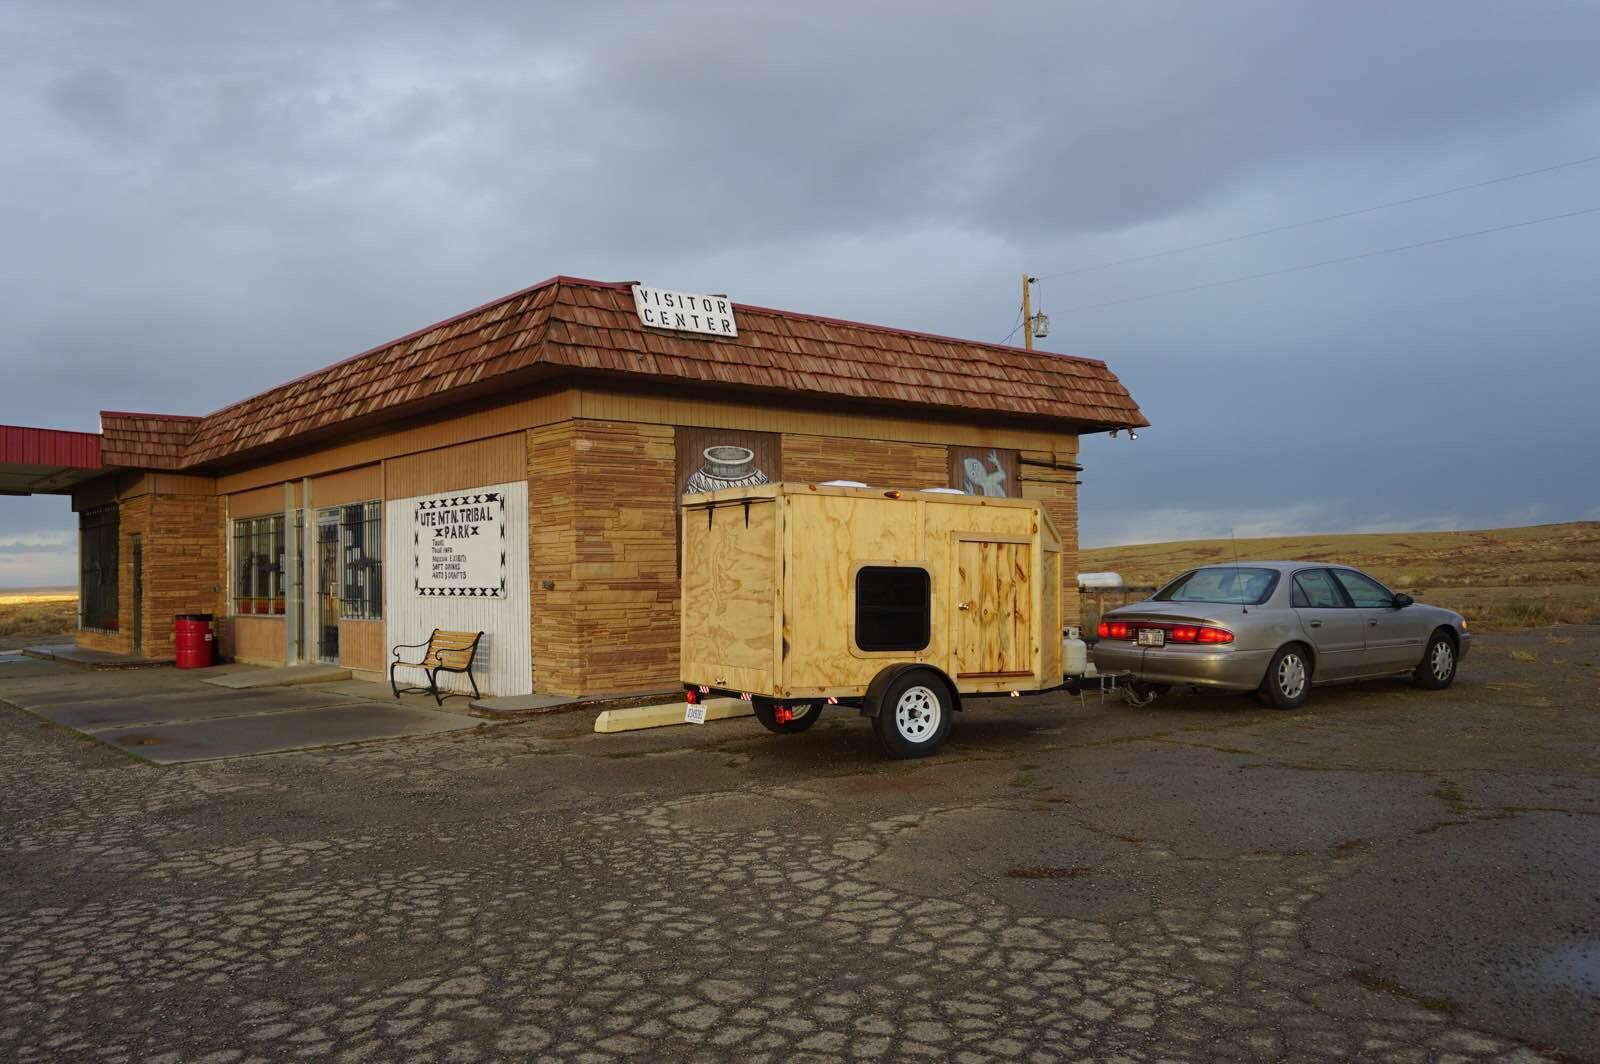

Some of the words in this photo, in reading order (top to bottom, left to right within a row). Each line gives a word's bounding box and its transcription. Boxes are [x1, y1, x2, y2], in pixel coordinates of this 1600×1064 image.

[640, 289, 727, 314] VISITOR
[643, 308, 732, 333] CENTER
[420, 512, 436, 527] UTE
[460, 506, 493, 523] TRIBAL
[444, 524, 470, 539] PARK
